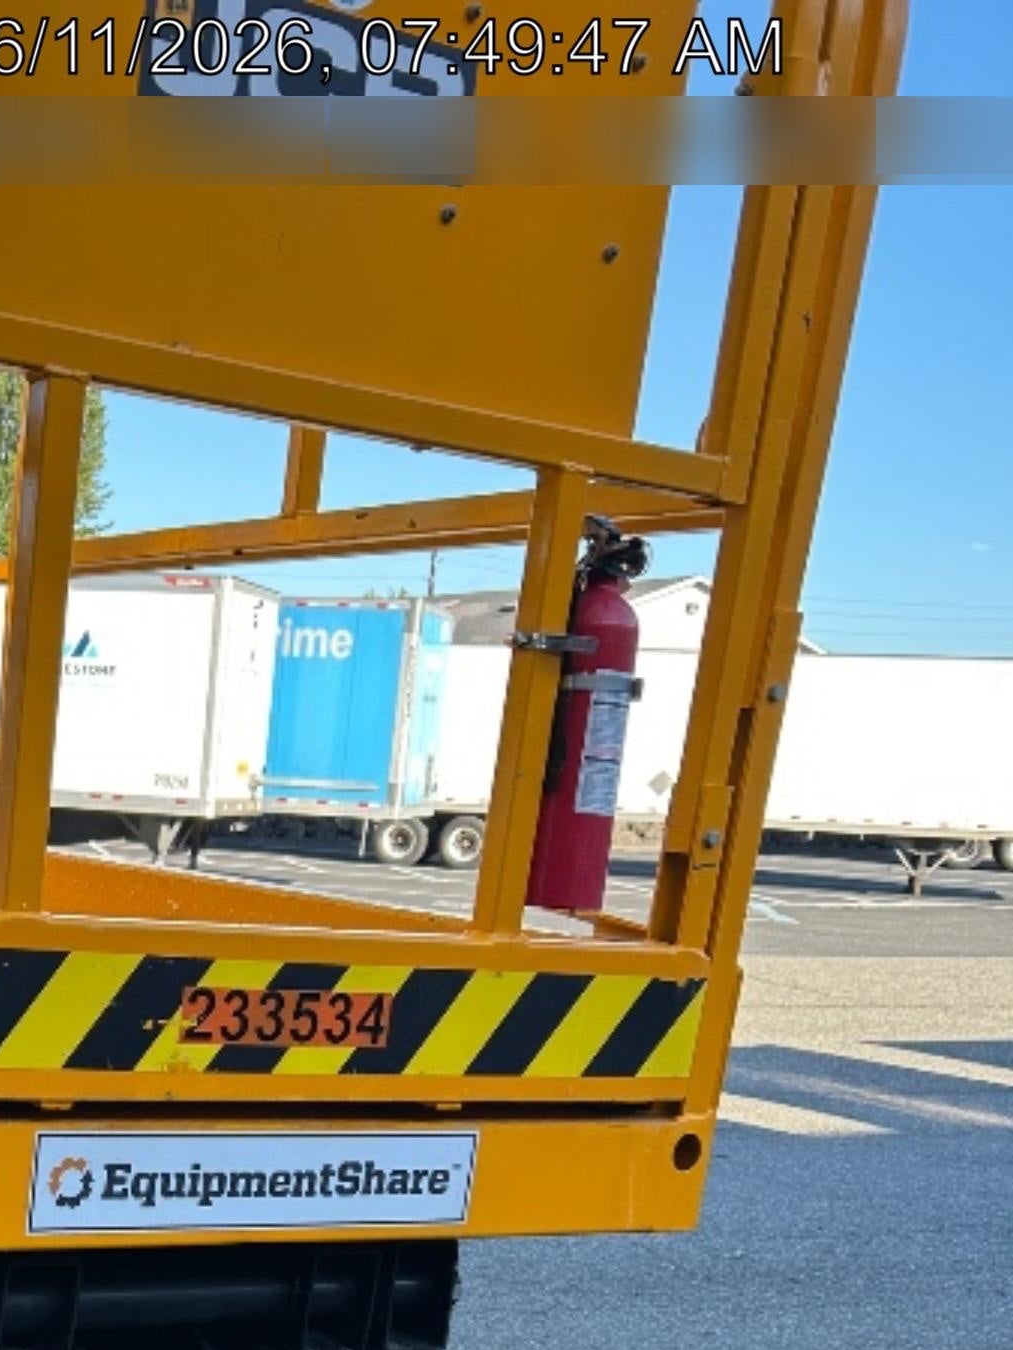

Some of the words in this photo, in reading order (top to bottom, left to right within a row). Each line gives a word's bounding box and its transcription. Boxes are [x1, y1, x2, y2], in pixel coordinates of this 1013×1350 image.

[275, 617, 355, 659] ime
[182, 987, 386, 1045] 233534
[100, 1160, 451, 1208] EquipmentShare
